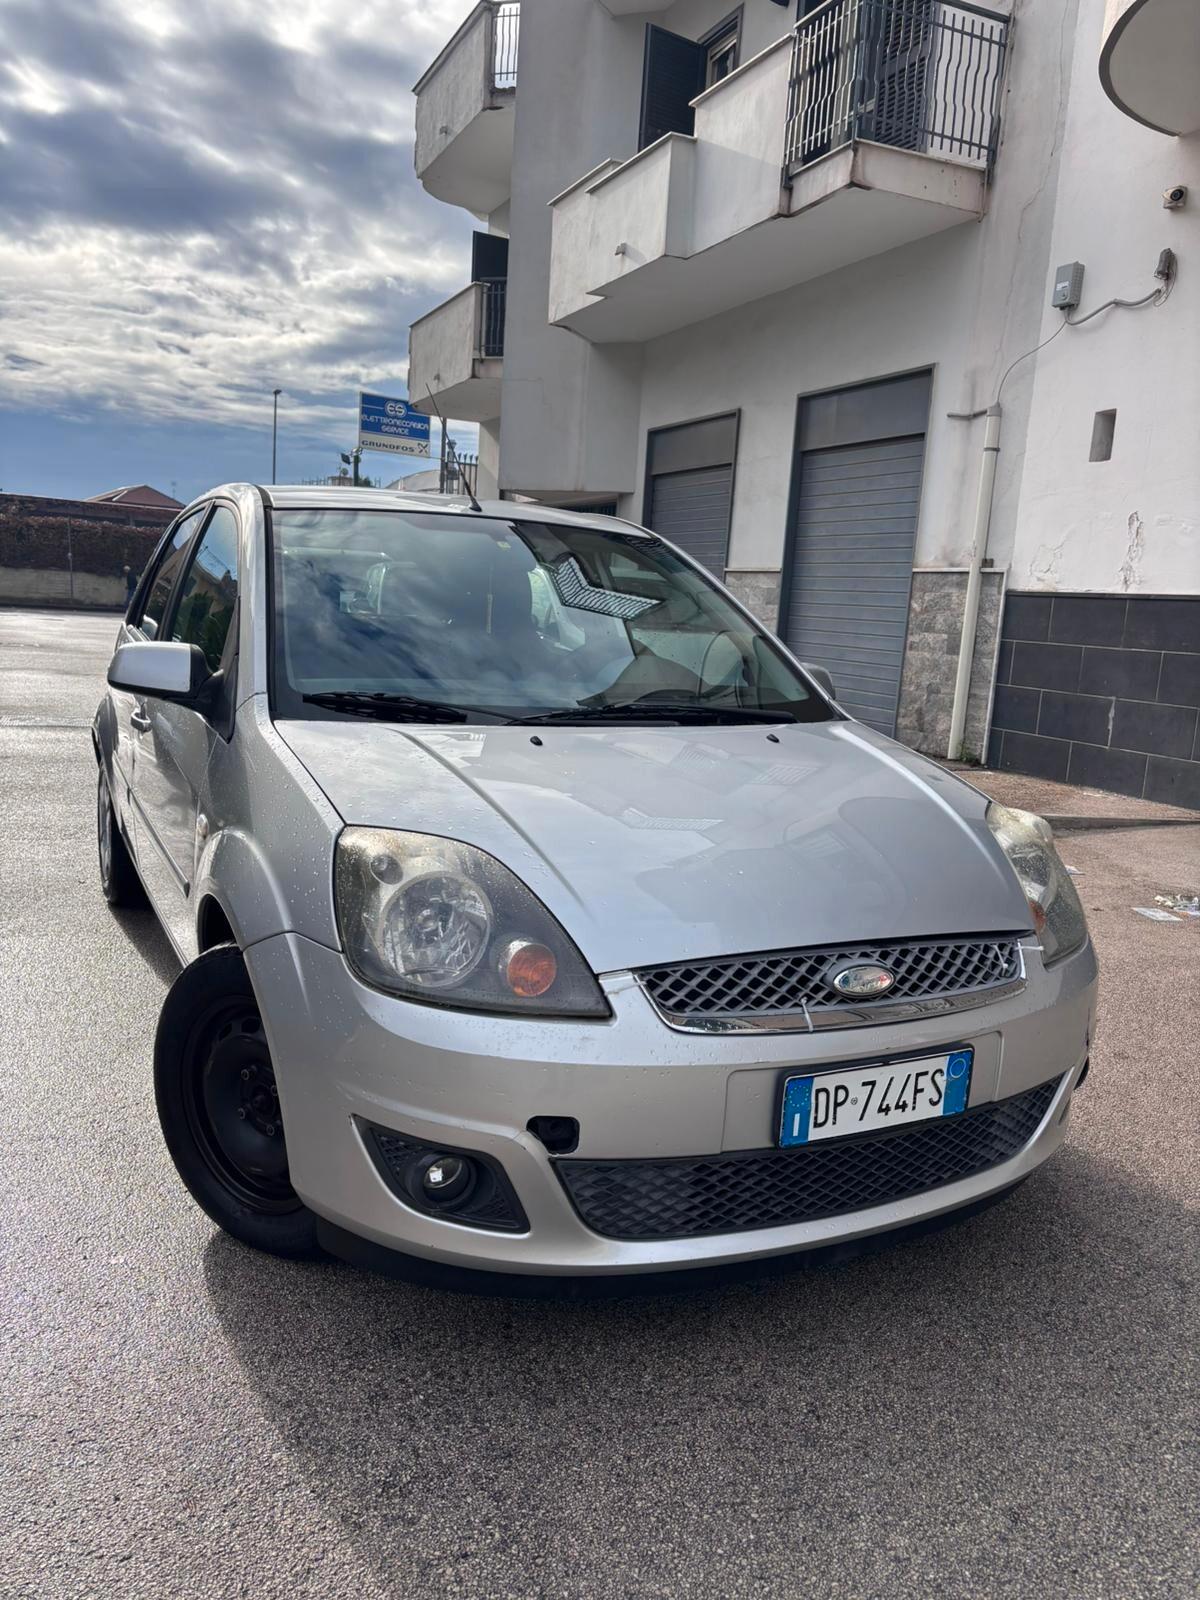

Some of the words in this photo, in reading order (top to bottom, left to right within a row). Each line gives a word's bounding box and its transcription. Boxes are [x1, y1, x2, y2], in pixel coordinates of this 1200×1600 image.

[381, 425, 409, 435] SERVICE
[361, 440, 415, 452] GRUNDFOS
[813, 1084, 849, 1128] DP
[858, 1068, 945, 1121] 744FS
